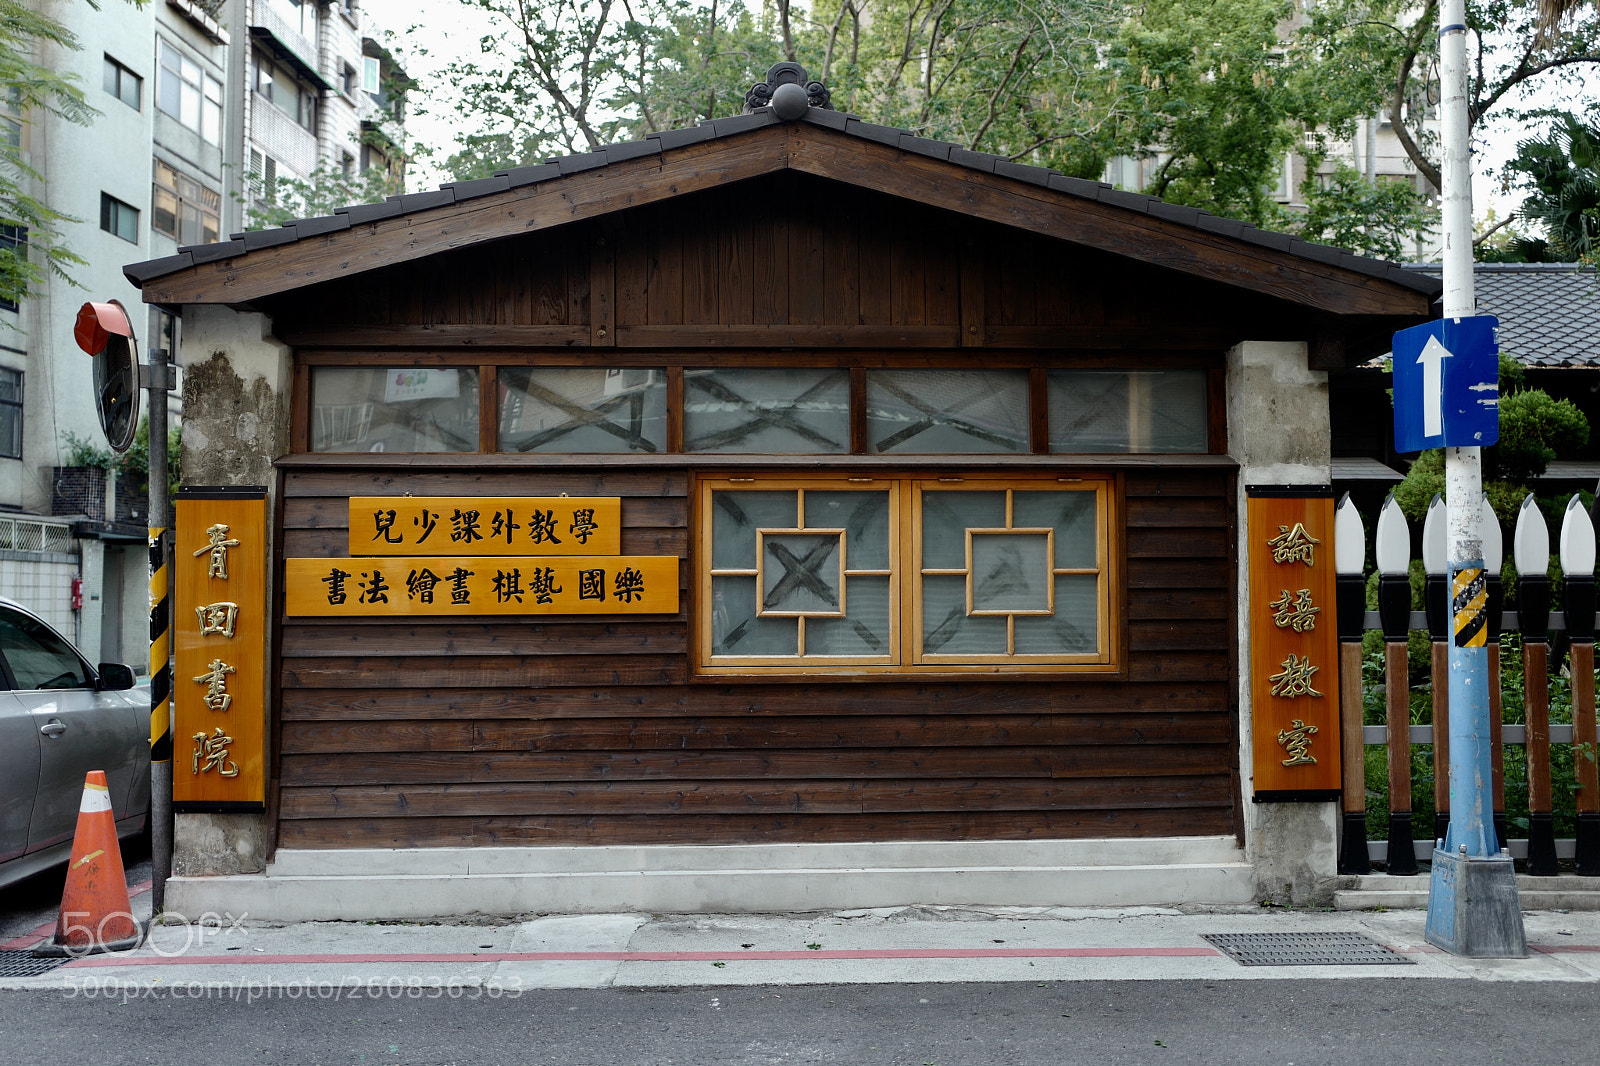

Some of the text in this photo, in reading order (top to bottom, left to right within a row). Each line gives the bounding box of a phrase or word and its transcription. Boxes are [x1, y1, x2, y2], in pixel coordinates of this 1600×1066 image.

[372, 508, 599, 545] 兒少課外教學
[1266, 522, 1324, 767] 論語教室
[191, 523, 241, 778] 青田書院
